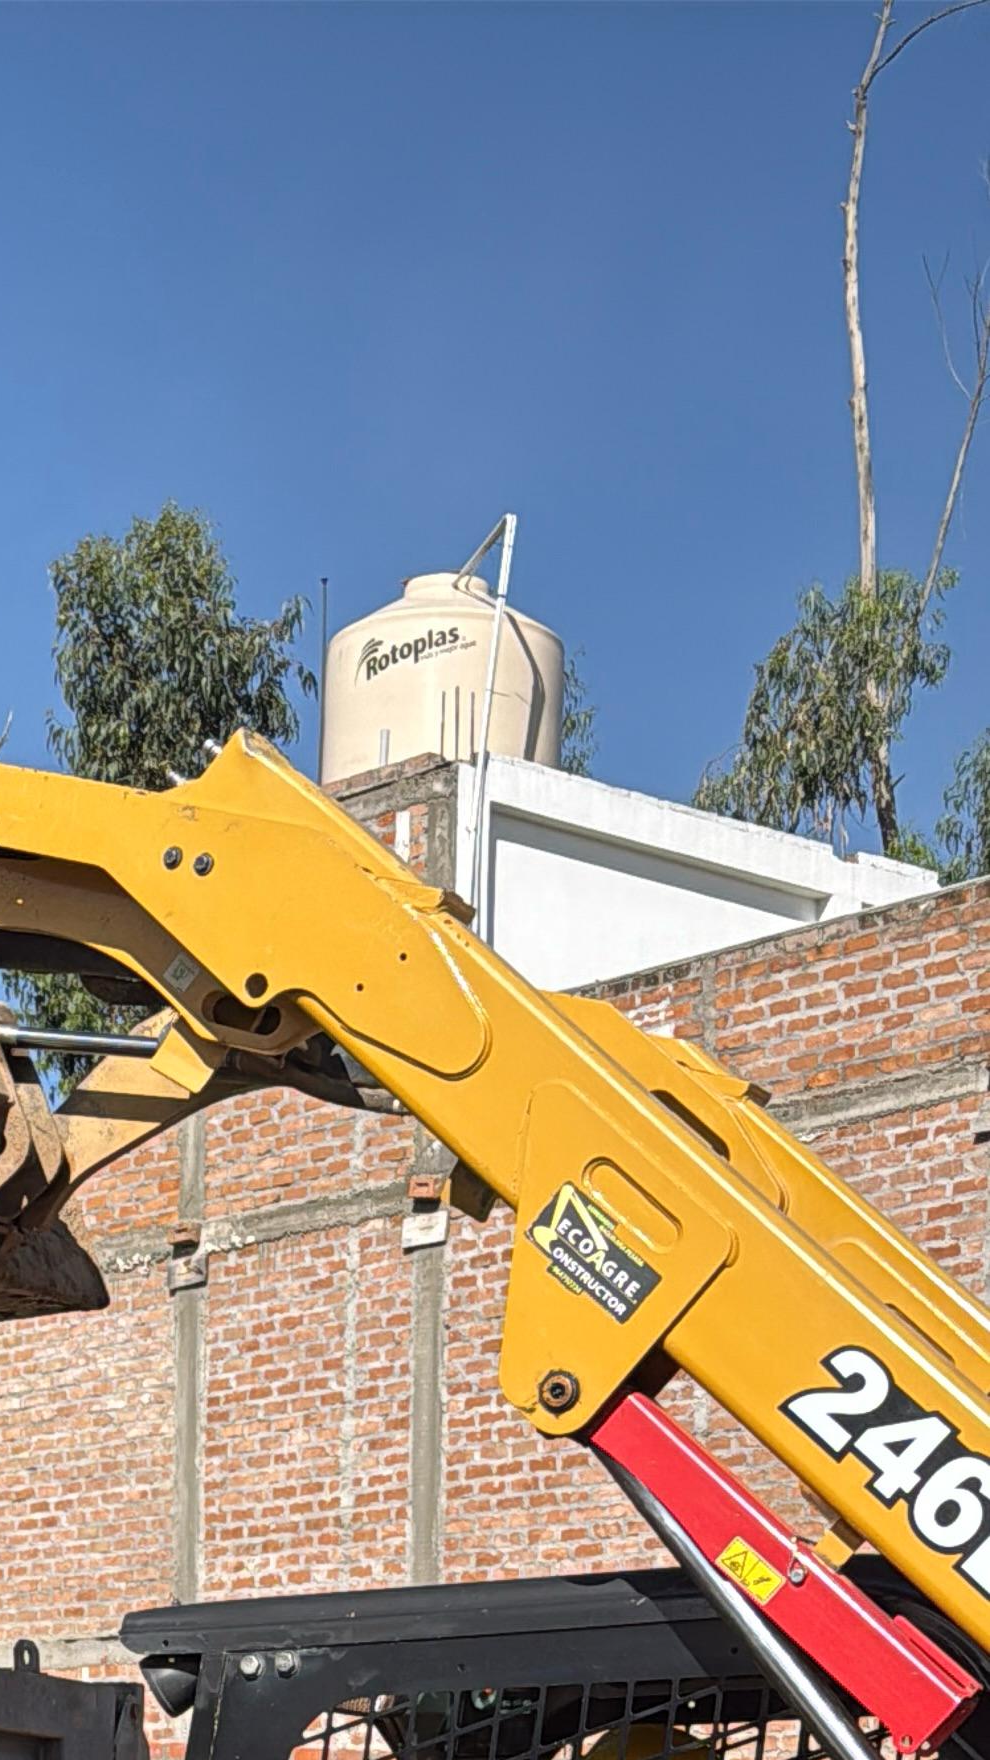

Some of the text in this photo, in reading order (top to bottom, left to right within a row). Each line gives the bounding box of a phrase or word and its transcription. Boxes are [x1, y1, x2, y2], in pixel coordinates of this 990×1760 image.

[366, 626, 460, 681] Rotoplas
[556, 1217, 642, 1299] ECOAGRE
[780, 1346, 990, 1597] 246
